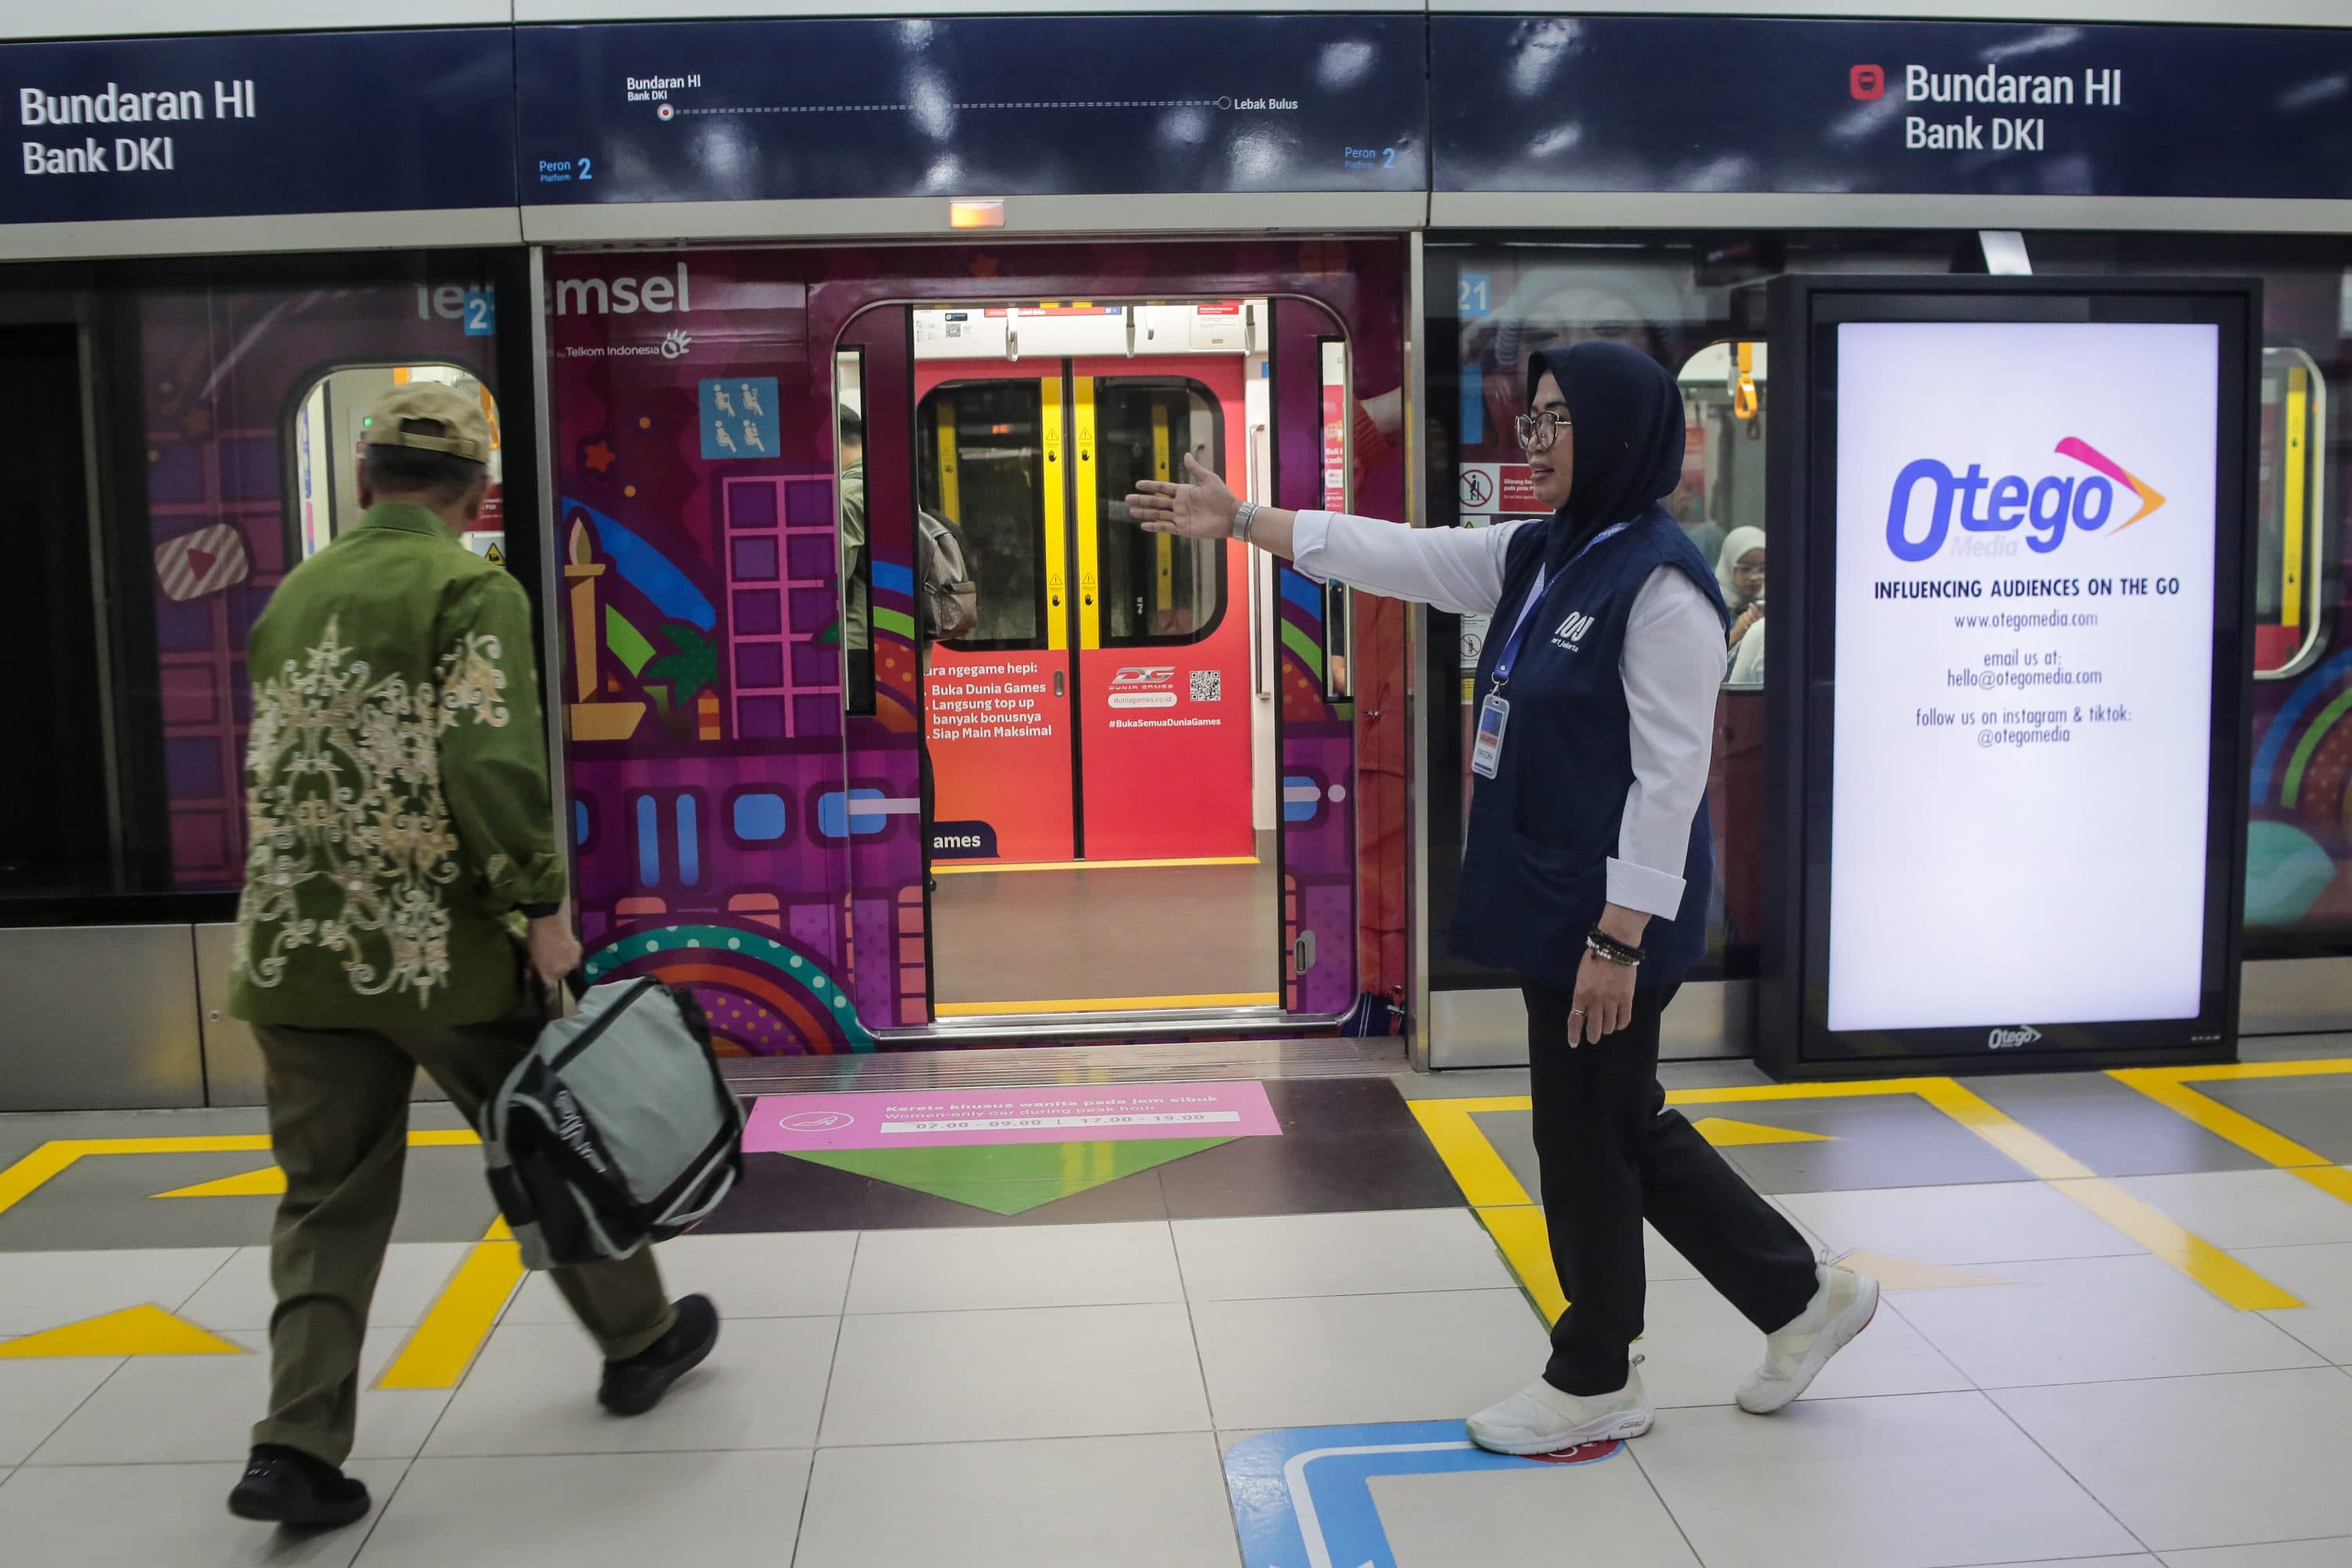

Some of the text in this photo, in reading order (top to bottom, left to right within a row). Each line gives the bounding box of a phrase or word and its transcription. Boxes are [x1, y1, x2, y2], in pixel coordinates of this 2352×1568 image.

[627, 74, 701, 90] Bundaran HI
[1906, 64, 2122, 106] Bundaran HI
[20, 79, 256, 125] Bundaran HI
[627, 90, 667, 102] Bank DKI
[1234, 97, 1298, 110] Lebak Bulus
[1906, 115, 2045, 151] Bank DKI
[22, 136, 175, 175] Bank DKI
[1345, 147, 1396, 169] Peron 2
[539, 157, 593, 180] Peron 2
[540, 173, 572, 182] Platform
[556, 261, 691, 316] msel
[1457, 280, 1487, 310] 21
[565, 346, 605, 358] Telkom
[607, 345, 660, 356] Indonesia
[1886, 458, 2114, 562] Otego
[1950, 534, 2019, 557] Media
[1874, 577, 2180, 599] INFLUENCING AUDIENCES ON THE GO
[1954, 609, 2099, 633] www.otegomedia.com
[1983, 648, 2062, 666] email us at:
[948, 664, 1005, 678] ngegame
[1007, 662, 1038, 675] hepi:
[1947, 667, 2103, 691] hello@otegomedia.com
[931, 682, 1047, 696] Buka Dunia Games
[932, 698, 1035, 712] Langsung top up
[1113, 695, 1172, 704] duniagames.co.id
[933, 711, 1042, 727] banyak bonusnya
[1109, 717, 1221, 728] #BukaSemuaDuniaGames
[1915, 704, 2132, 728] follow us on instagram & tiktok:
[932, 724, 1052, 741] Siap Main Maksimal
[1976, 726, 2071, 748] @otegomedia
[933, 835, 982, 849] ames
[1988, 1028, 2033, 1049] Otego
[1083, 1098, 1127, 1107] pada
[885, 1110, 984, 1120] Women-only
[916, 1121, 969, 1130] 07.00
[989, 1119, 1042, 1127] 09.00
[1153, 1113, 1205, 1122] 19.00
